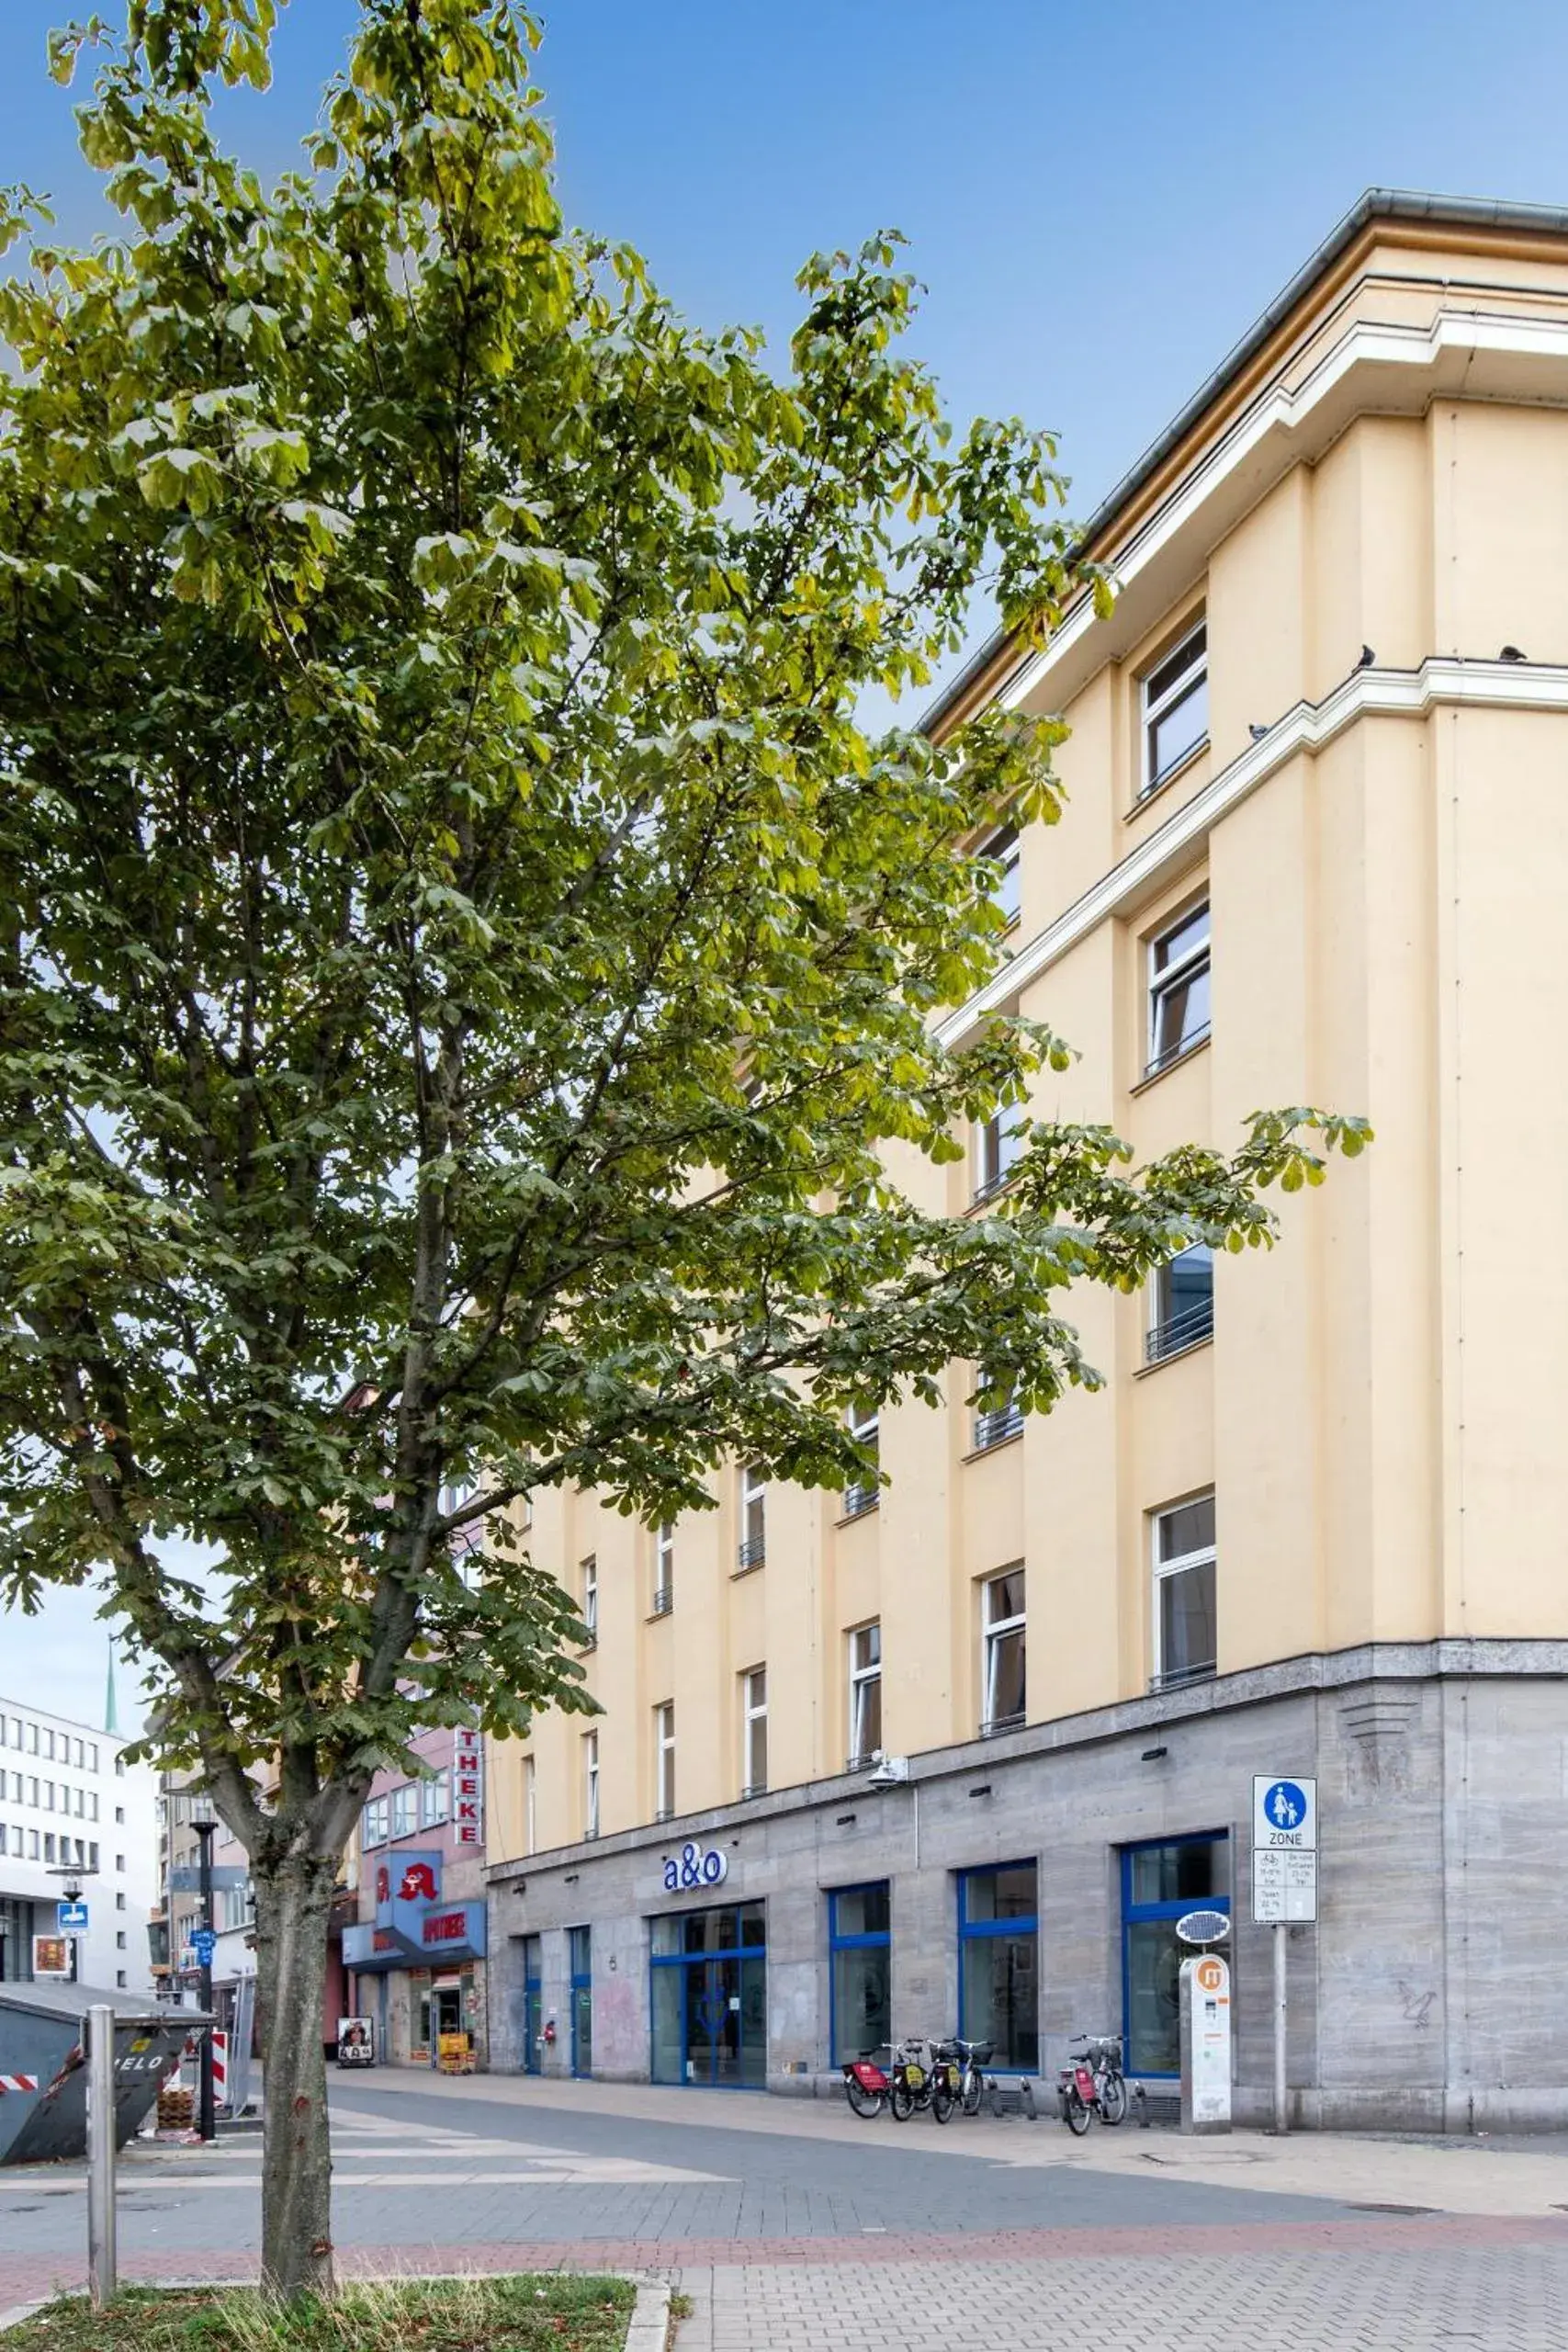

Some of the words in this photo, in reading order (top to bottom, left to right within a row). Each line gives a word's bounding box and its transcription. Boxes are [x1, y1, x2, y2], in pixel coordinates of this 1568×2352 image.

[1269, 1832, 1303, 1846] ZONE
[664, 1842, 726, 1890] a&o
[114, 2056, 163, 2071] ELO
